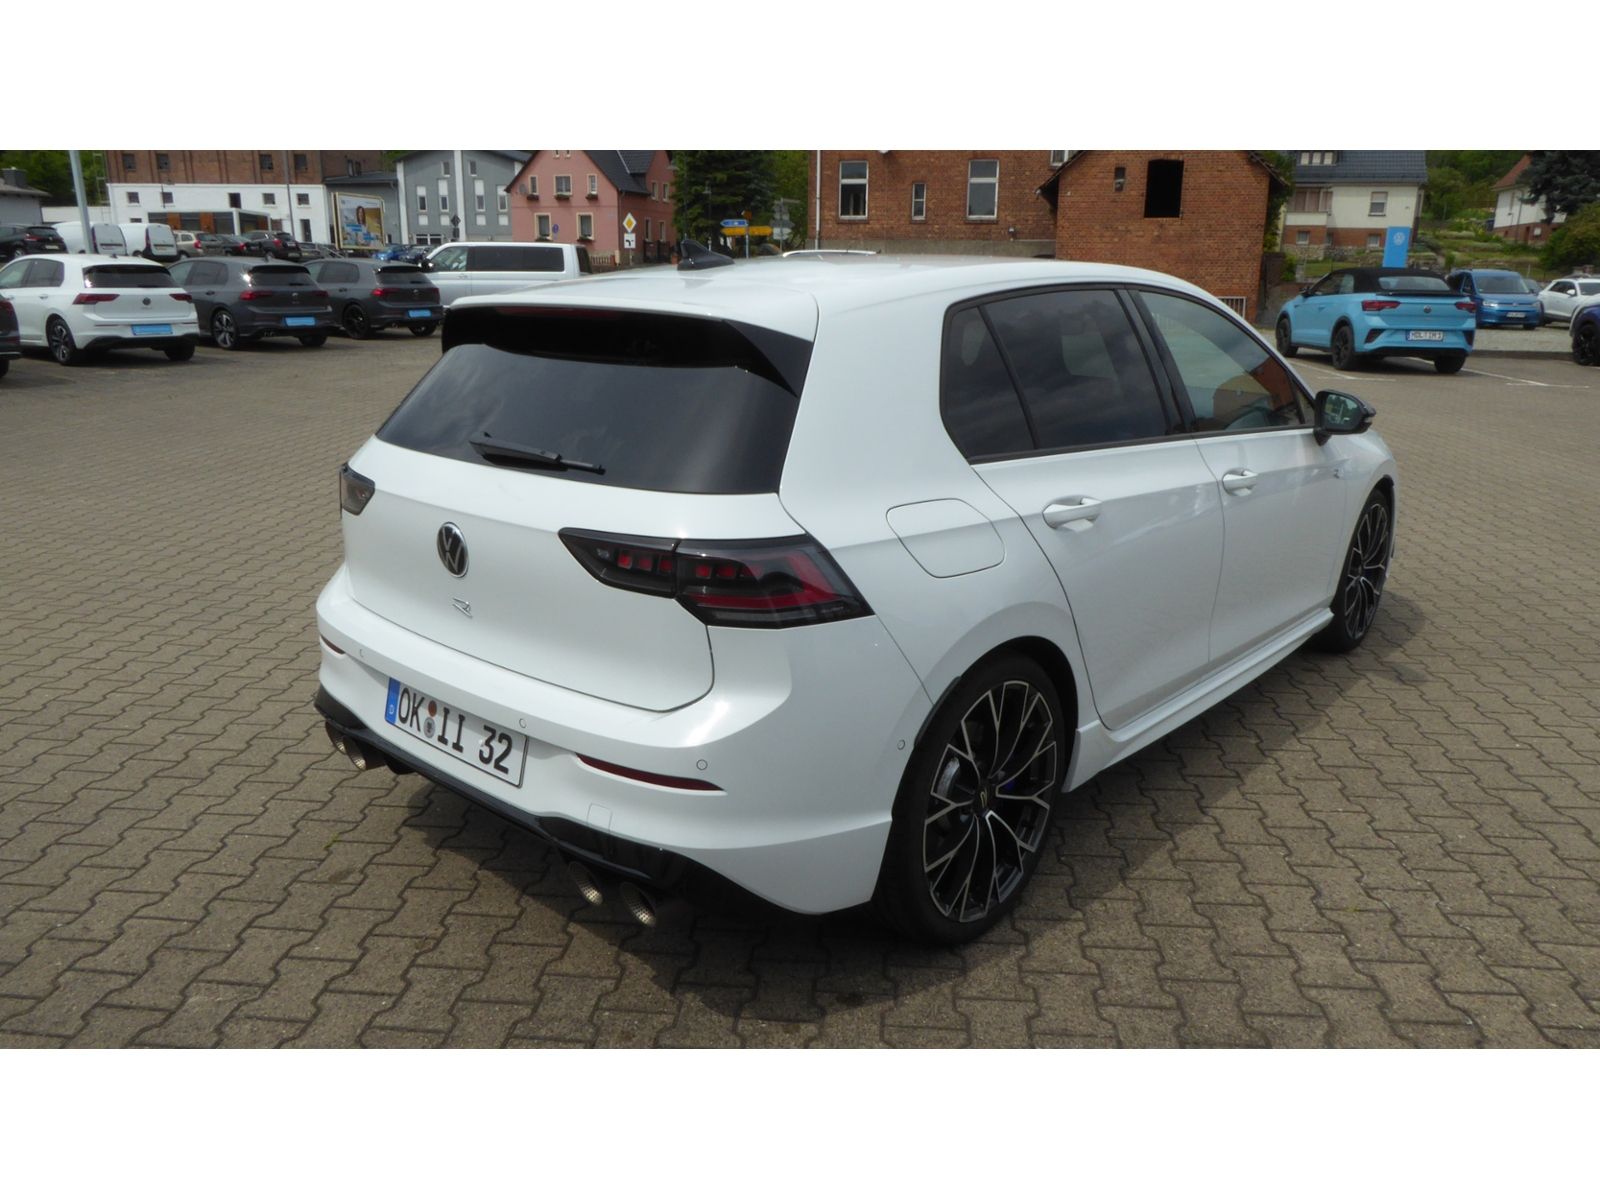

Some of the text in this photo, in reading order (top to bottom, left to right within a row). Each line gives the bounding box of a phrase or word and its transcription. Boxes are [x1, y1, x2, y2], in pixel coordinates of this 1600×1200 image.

[398, 687, 425, 732] OK
[437, 707, 466, 753] II
[479, 724, 513, 775] 32
